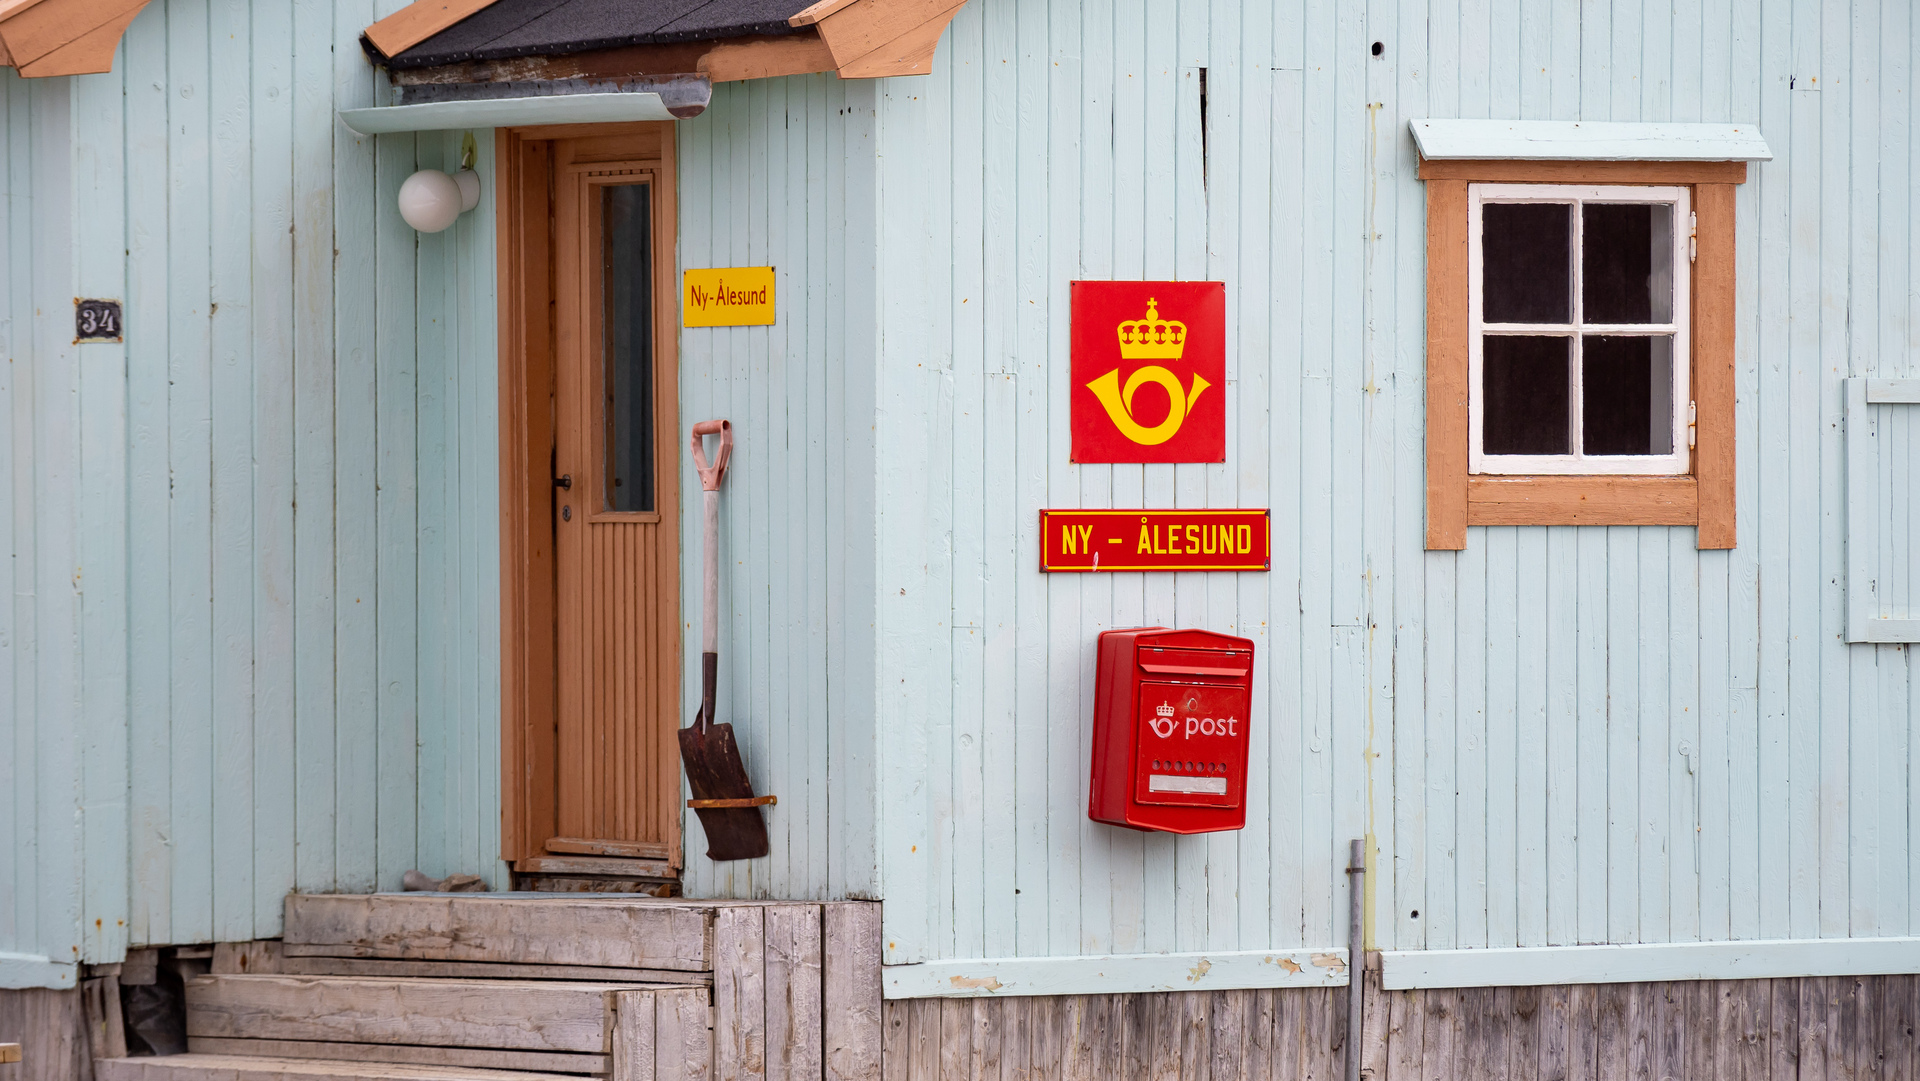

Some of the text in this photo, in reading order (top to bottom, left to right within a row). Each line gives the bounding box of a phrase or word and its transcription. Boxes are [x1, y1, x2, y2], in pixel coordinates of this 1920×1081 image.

[691, 279, 766, 311] Ny-Ålesund
[82, 309, 115, 334] 34
[1062, 524, 1094, 555] NY
[1137, 516, 1252, 555] ÅLESUND
[1185, 715, 1238, 740] post
